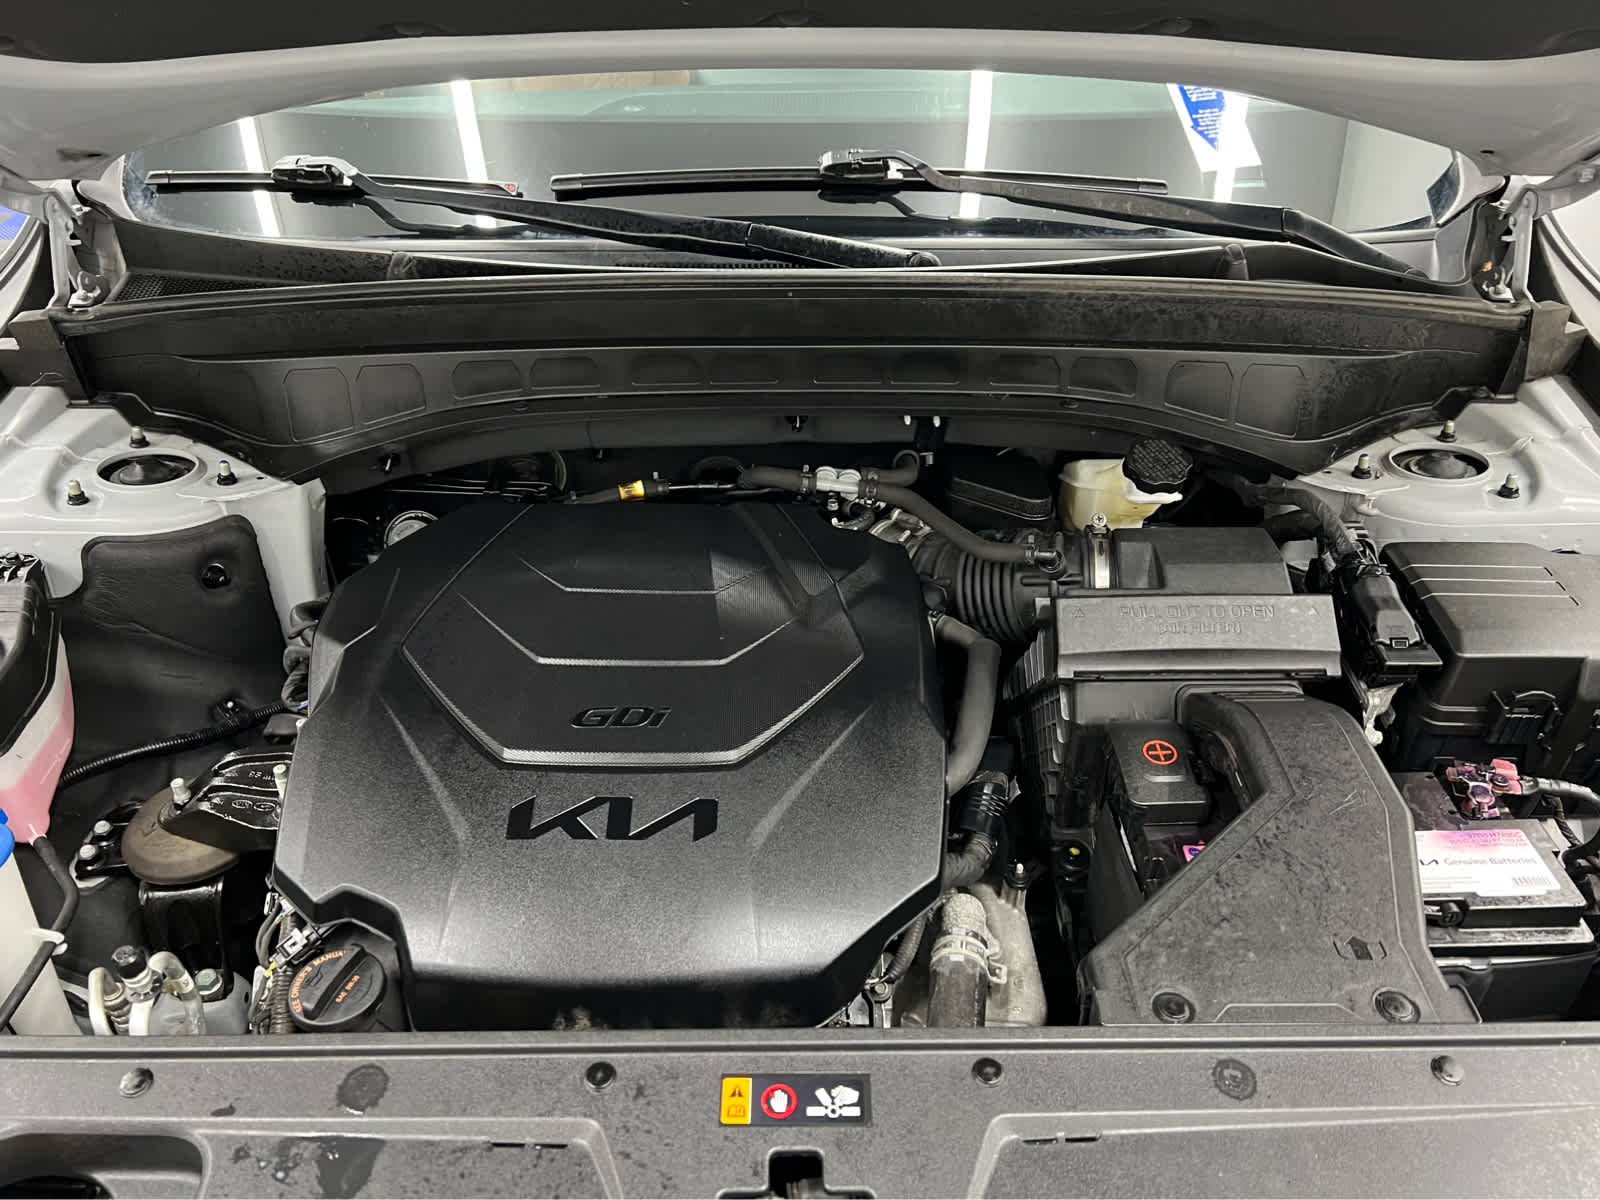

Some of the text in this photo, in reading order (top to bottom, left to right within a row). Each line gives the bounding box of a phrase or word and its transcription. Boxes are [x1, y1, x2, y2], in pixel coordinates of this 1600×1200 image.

[1167, 604, 1200, 618] OUT
[1205, 604, 1225, 618] TO
[1230, 604, 1275, 618] OPEN
[570, 706, 672, 729] GDi
[506, 795, 719, 842] KIA
